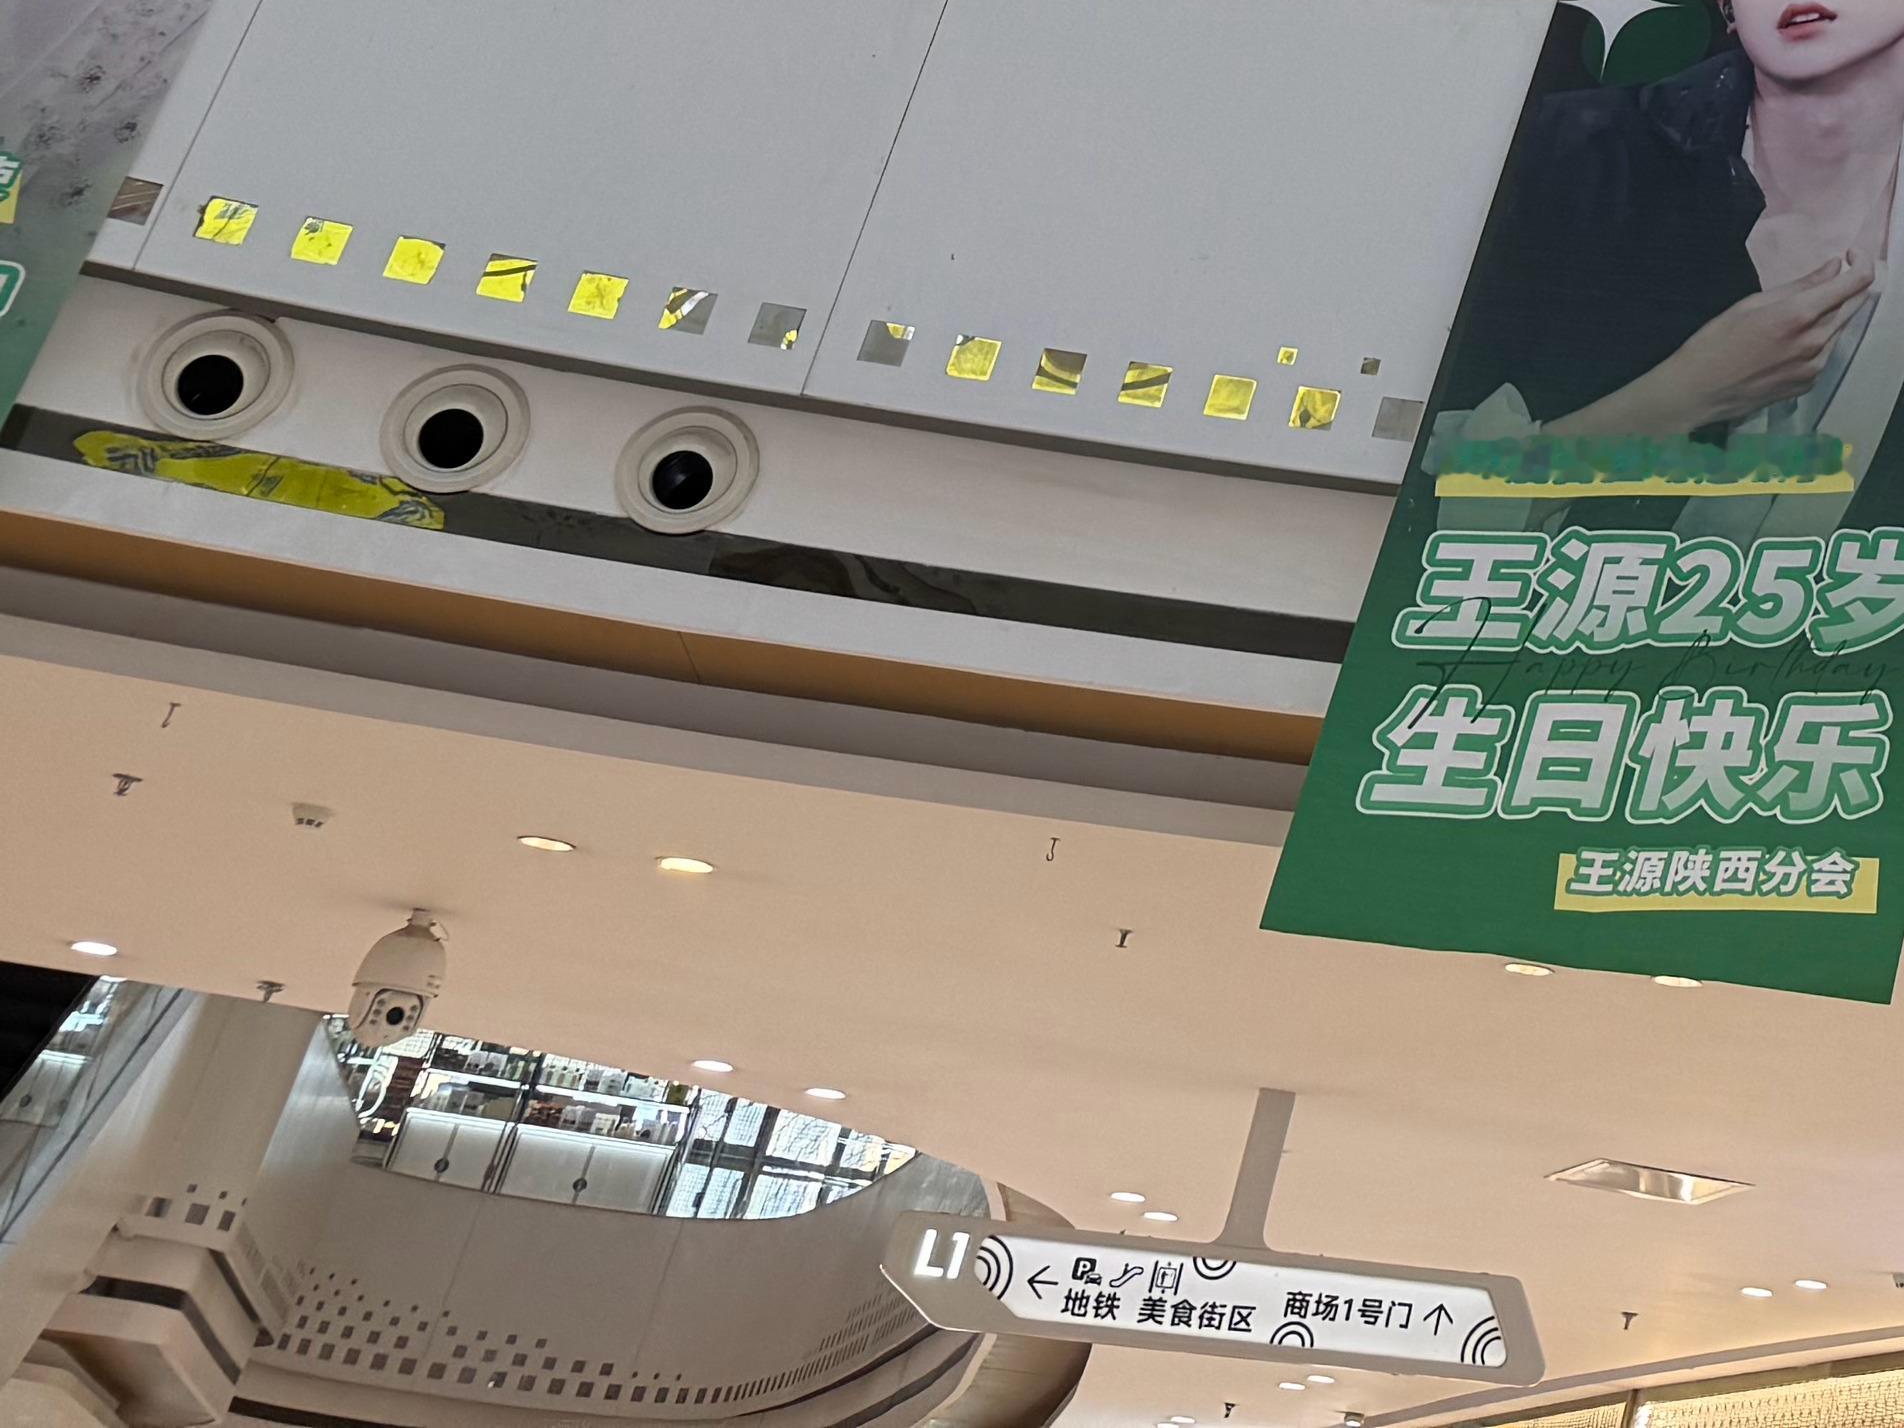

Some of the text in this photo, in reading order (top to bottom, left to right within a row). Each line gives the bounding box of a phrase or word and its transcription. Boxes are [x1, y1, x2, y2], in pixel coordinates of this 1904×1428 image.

[1360, 686, 1892, 821] 生日快乐
[1568, 848, 1855, 896] 王源陕西分会
[913, 1228, 970, 1279] L1
[1061, 1289, 1413, 1333] 地铁 美食街区 商场1号门
